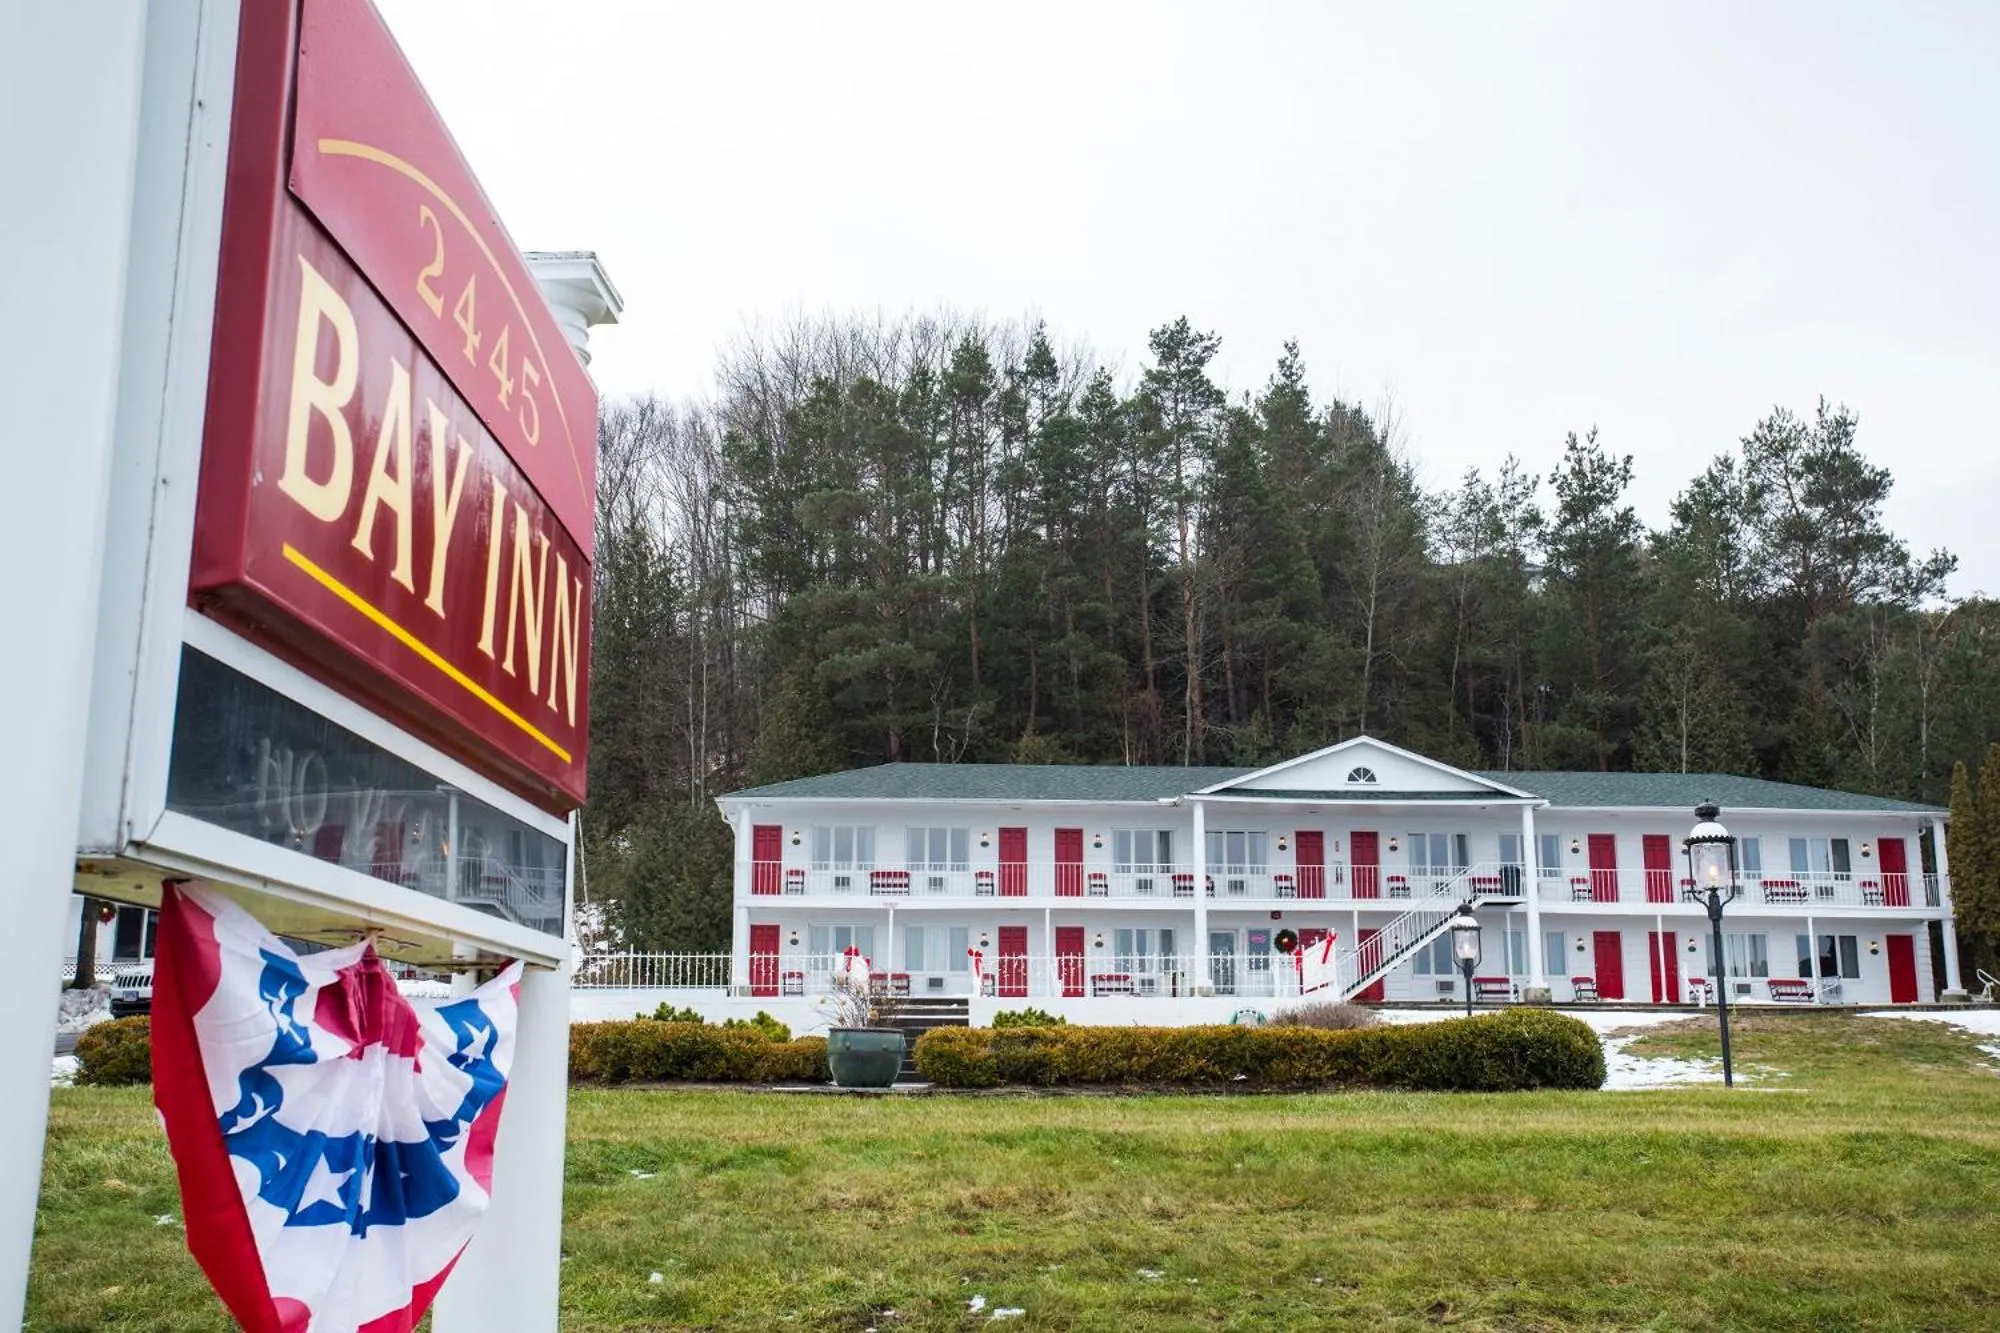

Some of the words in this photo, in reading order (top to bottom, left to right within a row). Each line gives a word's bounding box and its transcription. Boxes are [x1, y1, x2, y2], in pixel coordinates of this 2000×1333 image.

[277, 254, 474, 620] BAY
[477, 475, 583, 728] INN
[415, 204, 541, 447] 2445
